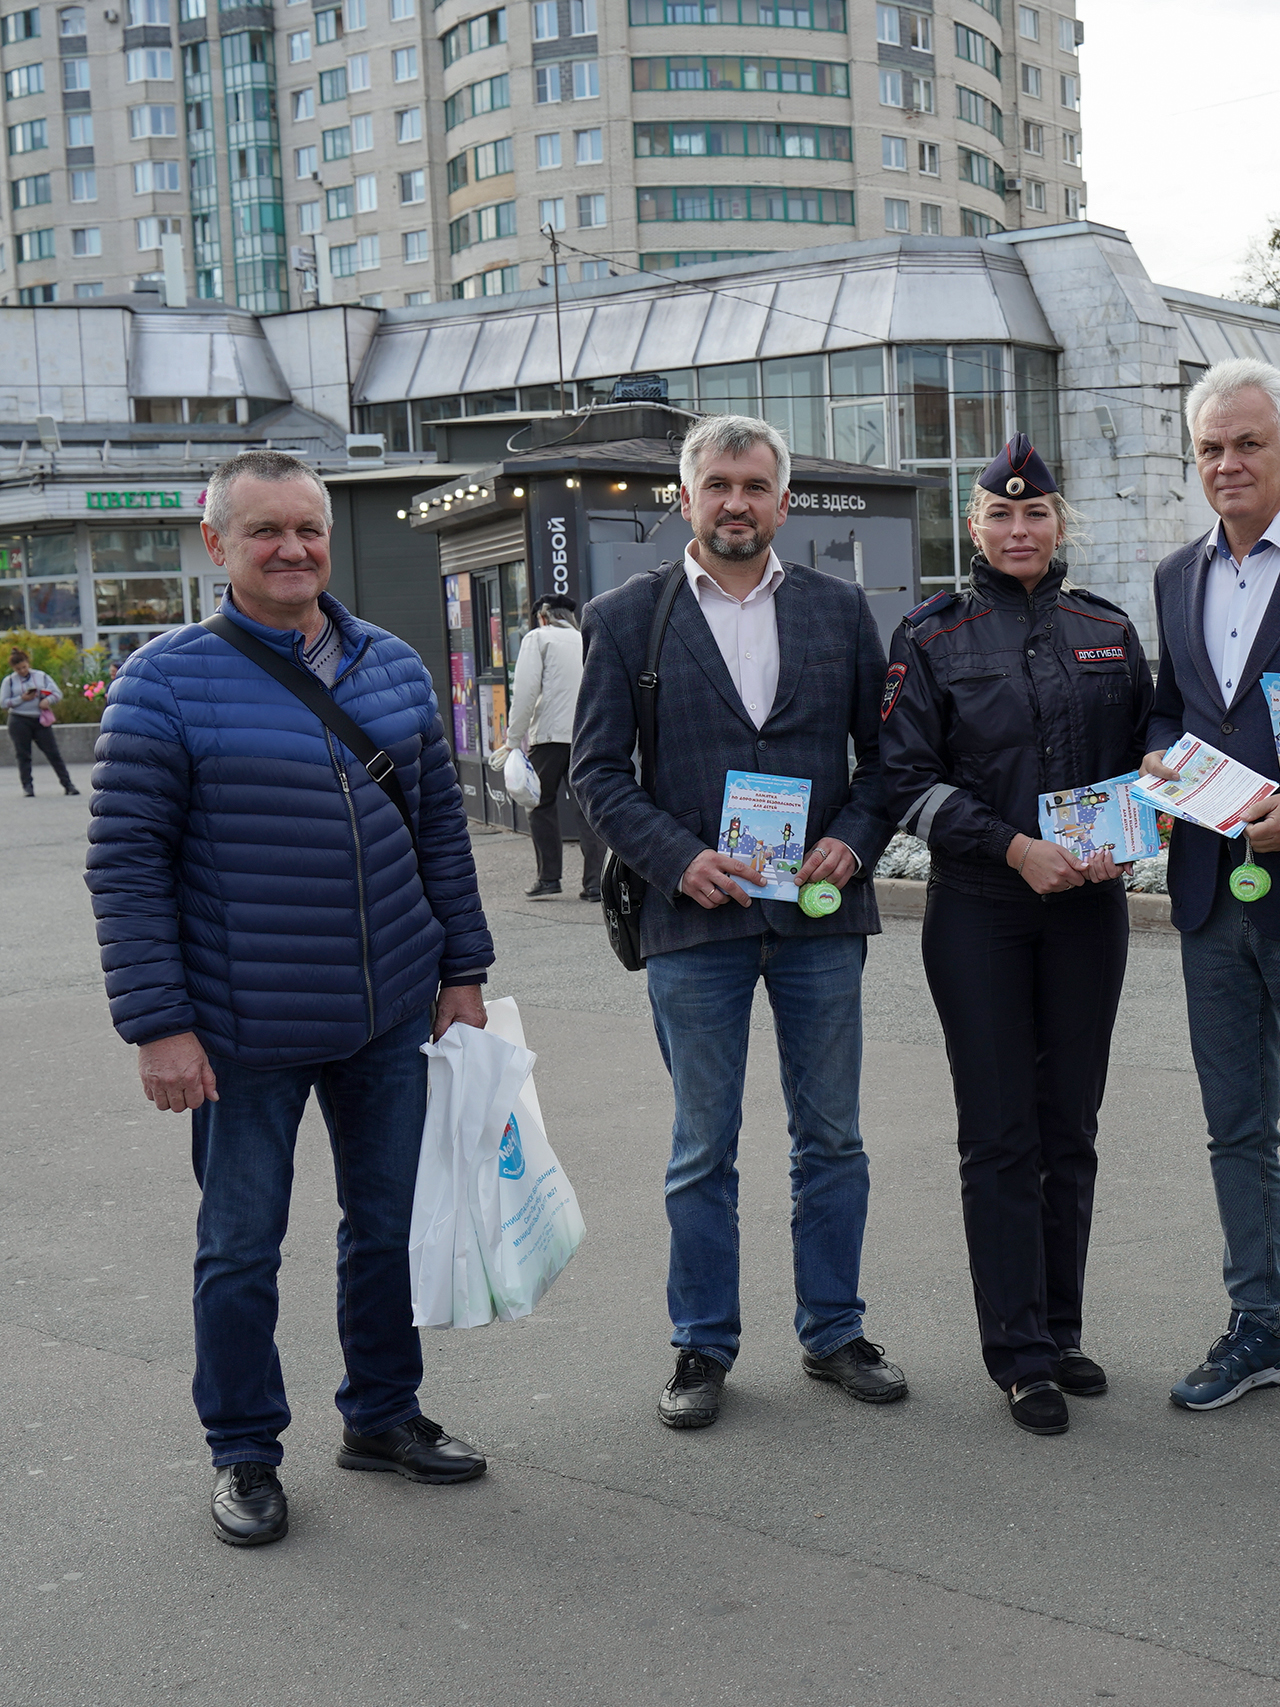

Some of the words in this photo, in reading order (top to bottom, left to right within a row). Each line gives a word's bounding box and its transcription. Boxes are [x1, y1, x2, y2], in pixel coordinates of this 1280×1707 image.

[86, 491, 182, 511] ЦВЕТЫ
[788, 492, 819, 509] ОФЕ
[822, 493, 866, 510] ЗДЕСЬ
[547, 517, 569, 596] СОБОЙ
[1078, 651, 1096, 660] ДПС
[1096, 648, 1124, 658] ГИБДД
